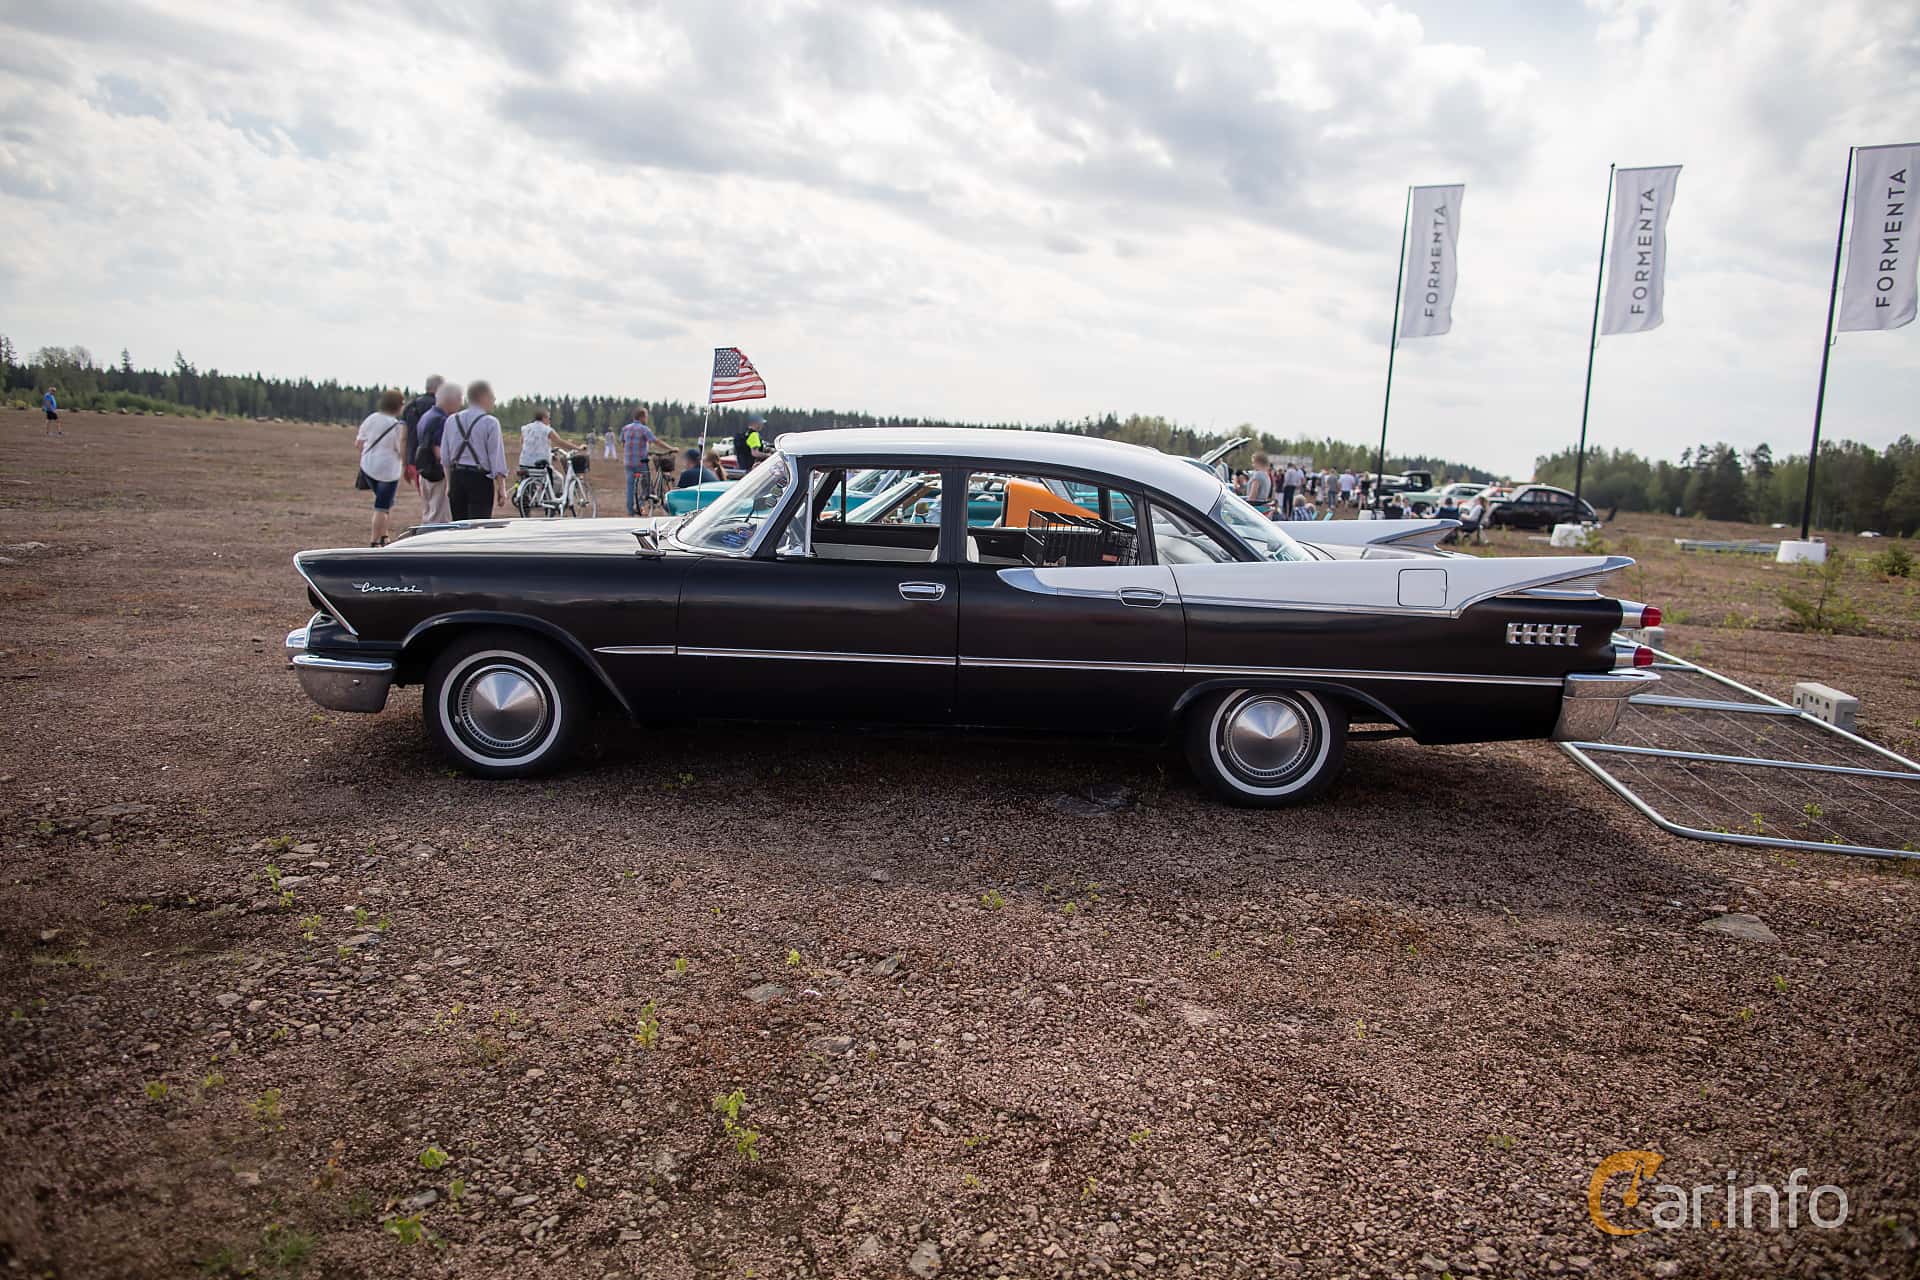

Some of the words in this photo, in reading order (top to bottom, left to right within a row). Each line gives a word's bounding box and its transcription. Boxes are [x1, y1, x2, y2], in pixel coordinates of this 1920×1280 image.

[1424, 203, 1448, 318] FORMENTA
[1631, 187, 1655, 315] FORMENTA
[1876, 168, 1908, 308] FORMENTA
[361, 582, 423, 593] Coronet
